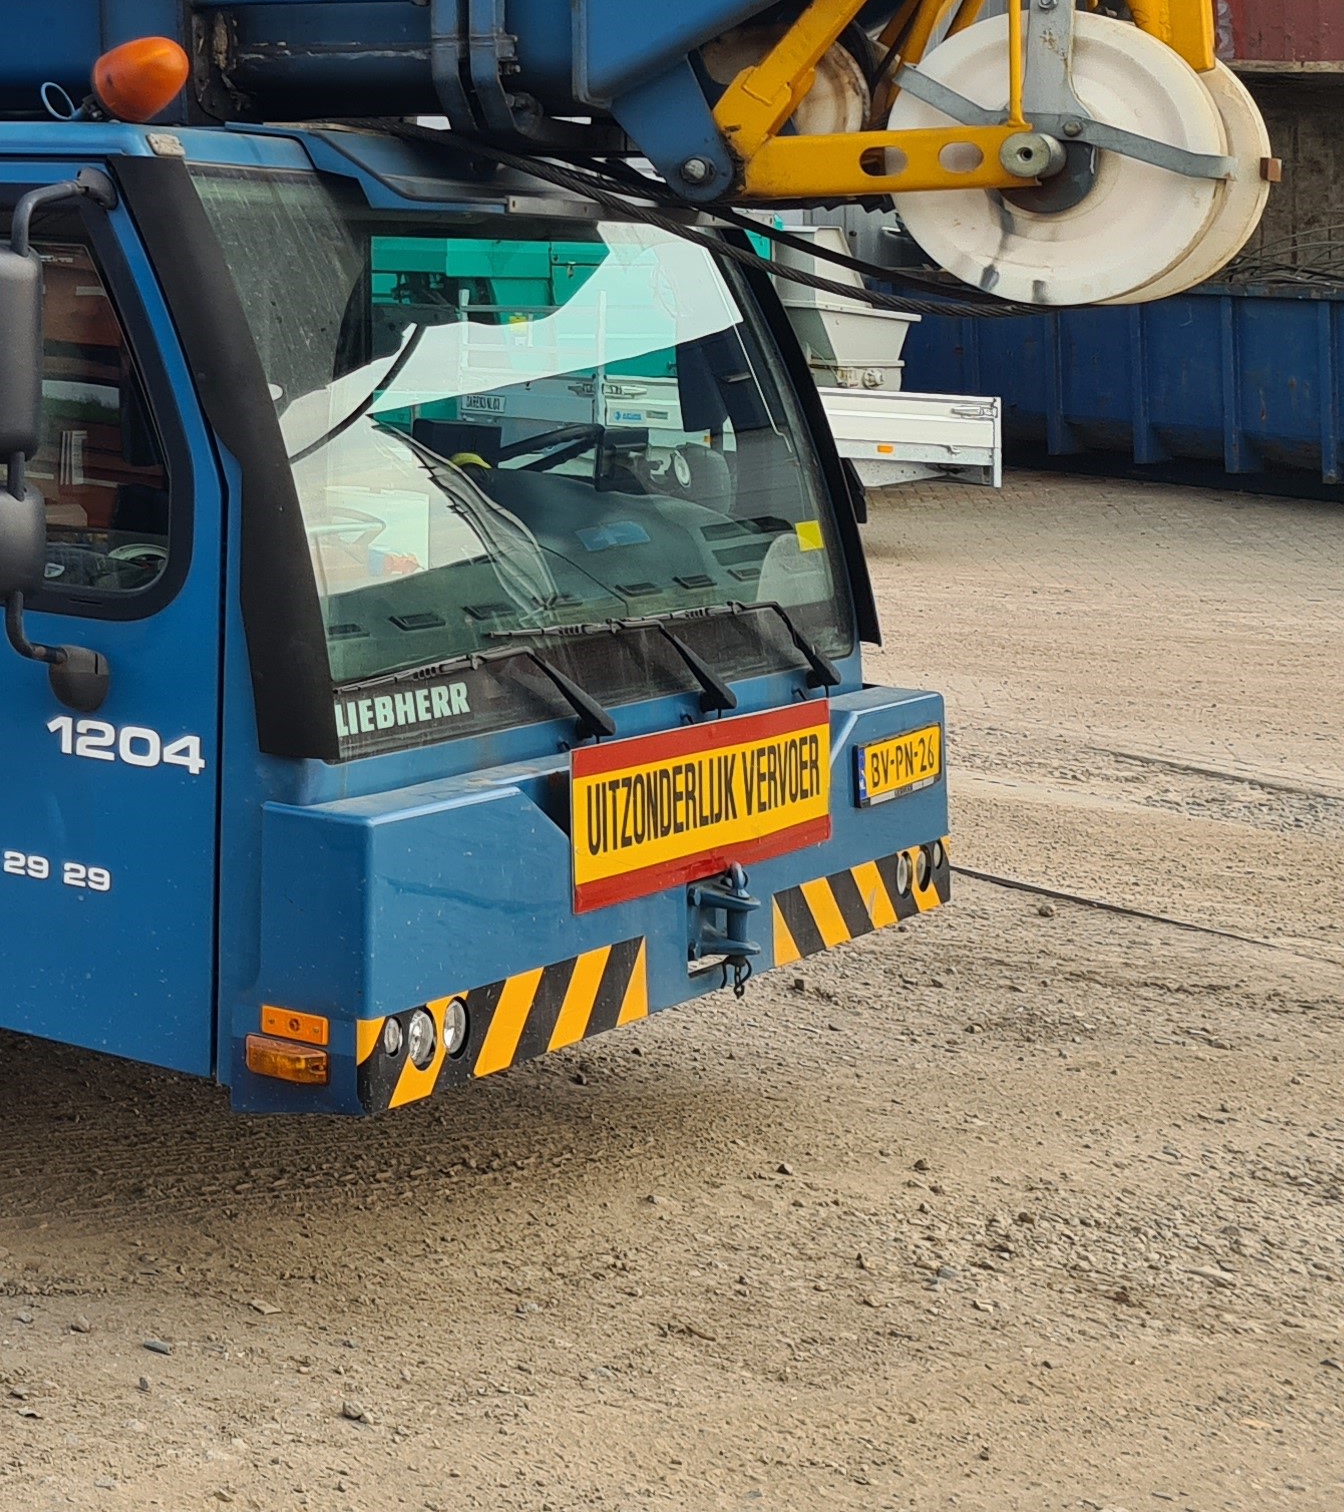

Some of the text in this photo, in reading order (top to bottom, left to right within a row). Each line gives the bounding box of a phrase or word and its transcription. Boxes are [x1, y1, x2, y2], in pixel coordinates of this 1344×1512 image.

[334, 681, 471, 738] LIEBHERR
[46, 715, 206, 775] 1204
[870, 734, 935, 789] BV-PN-26
[586, 733, 820, 856] UITZONDERLIJK VERVOER
[2, 851, 50, 880] 29
[62, 861, 111, 892] 29
